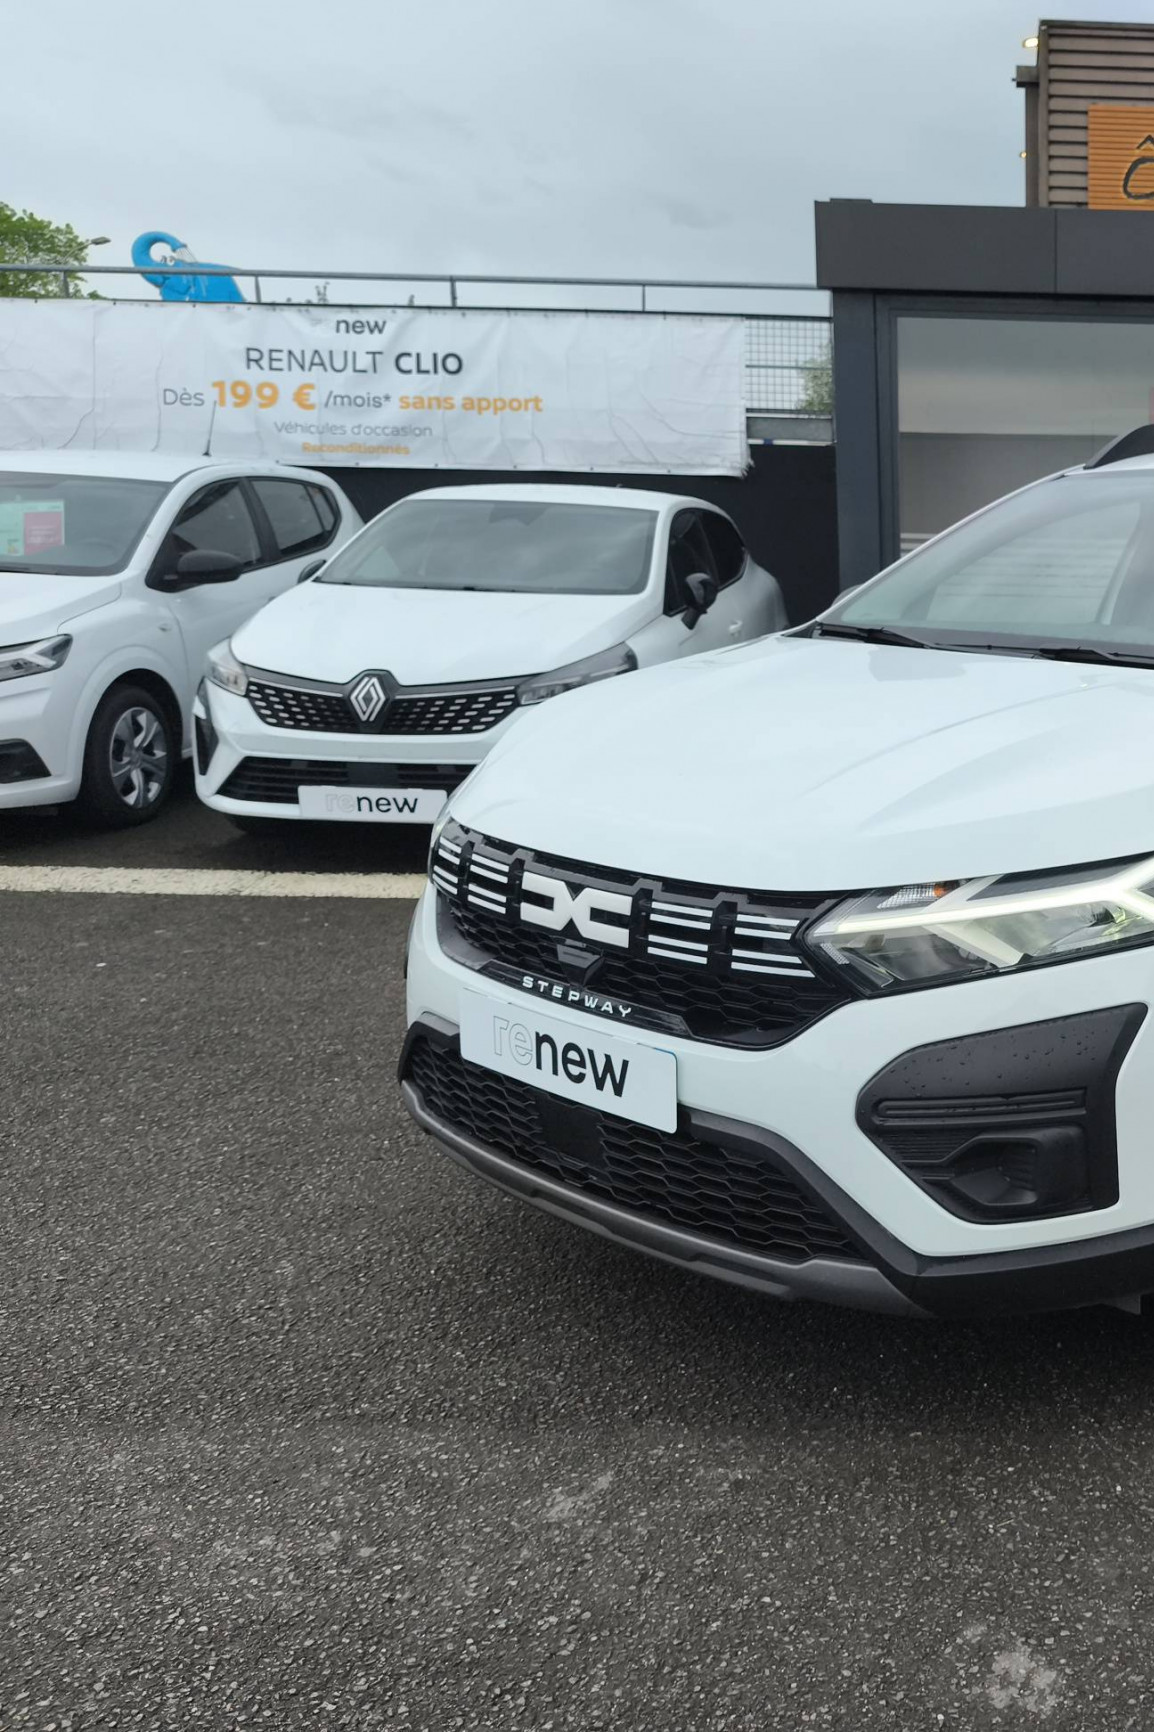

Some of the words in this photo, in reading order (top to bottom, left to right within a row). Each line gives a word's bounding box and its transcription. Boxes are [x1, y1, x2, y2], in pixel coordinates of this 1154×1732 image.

[335, 319, 387, 334] new
[245, 347, 384, 374] RENAULT
[394, 352, 463, 375] CLIO
[163, 388, 205, 406] Dès
[211, 379, 280, 409] 199
[292, 383, 316, 411] €
[398, 394, 455, 410] sans
[461, 395, 544, 415] apport
[273, 421, 347, 435] Véhicules
[351, 423, 433, 437] d'occasion
[522, 975, 633, 1018] STEPWAY
[492, 1014, 629, 1098] renew
